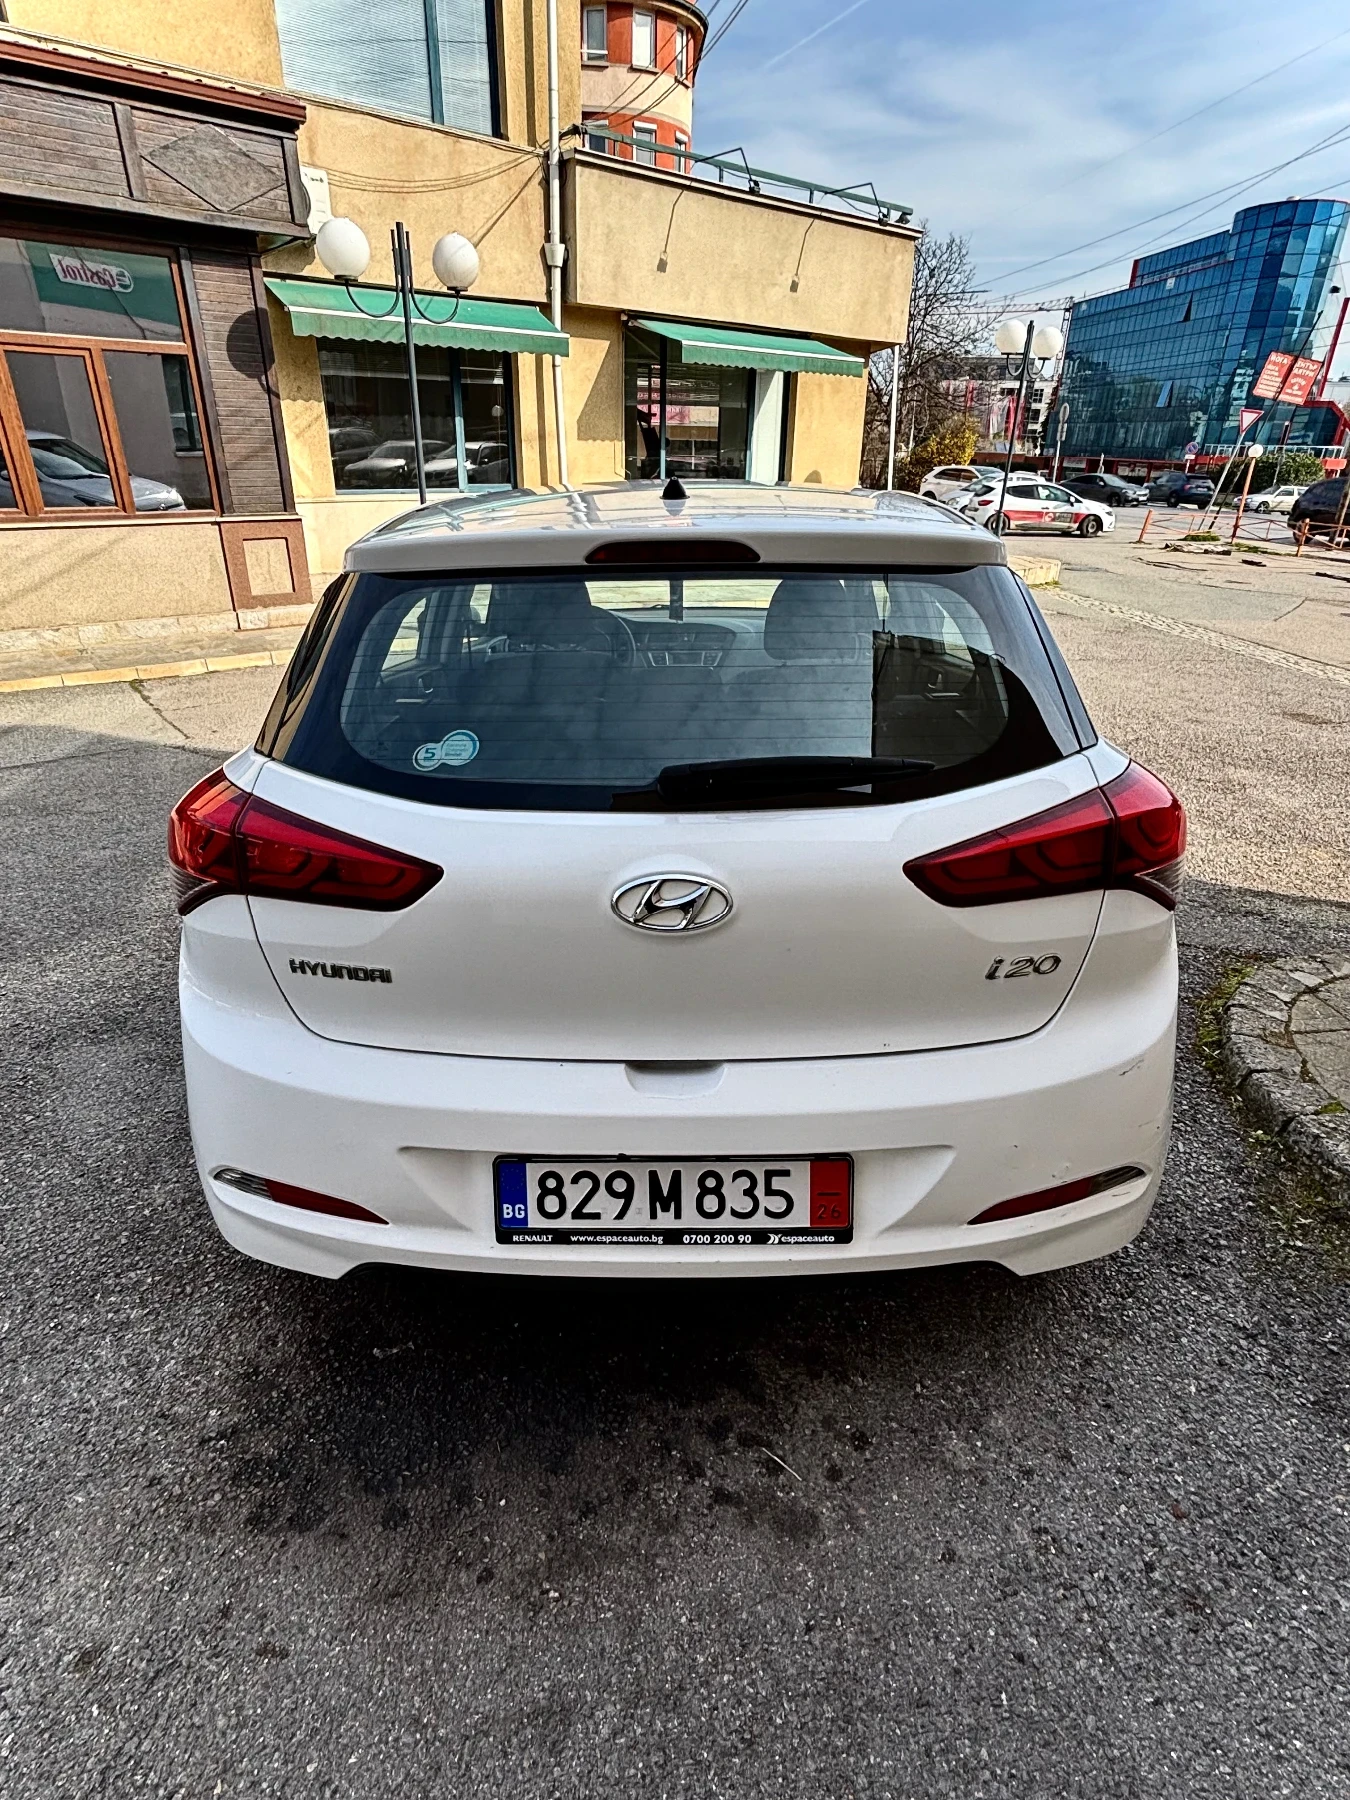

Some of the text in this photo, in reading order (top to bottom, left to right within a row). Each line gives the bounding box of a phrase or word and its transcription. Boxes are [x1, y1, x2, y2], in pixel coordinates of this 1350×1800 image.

[1296, 361, 1317, 370] ЕНТЪР
[424, 748, 437, 758] 5
[288, 958, 392, 983] HYUNDAI
[985, 953, 1061, 980] i20
[537, 1169, 795, 1220] 829 M 835
[502, 1203, 526, 1219] BG
[817, 1203, 841, 1219] 26
[512, 1234, 835, 1244] RENAULT www.espaceauto.bg 0700 200 90 espaceauto
